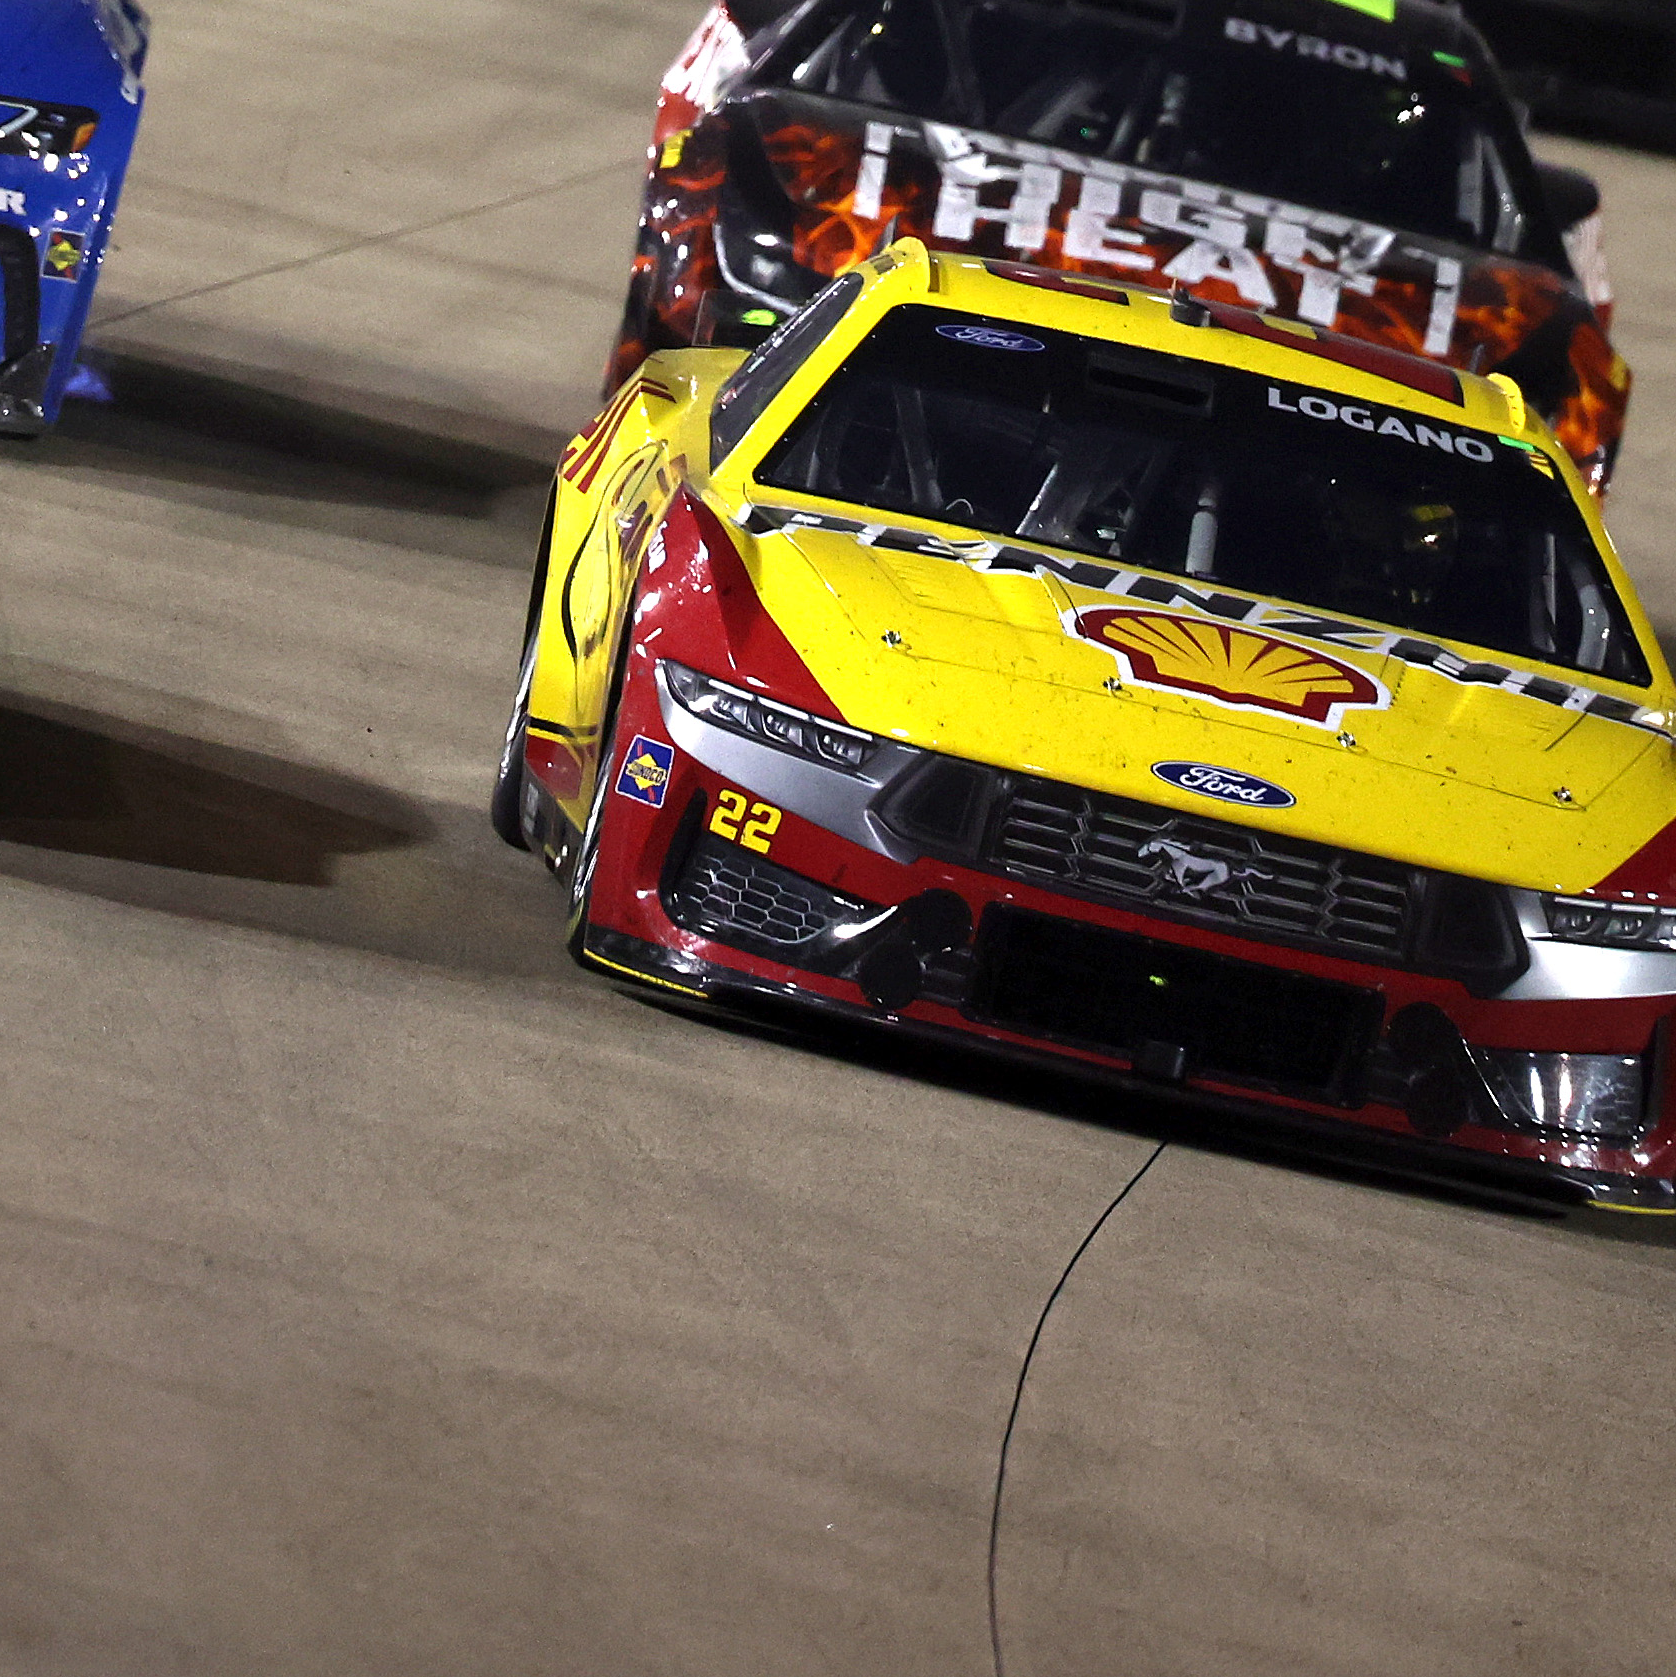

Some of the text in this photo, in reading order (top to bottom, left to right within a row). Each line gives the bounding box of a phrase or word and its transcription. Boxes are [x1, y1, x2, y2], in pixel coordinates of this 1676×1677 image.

[1224, 17, 1407, 81] BYRON
[931, 186, 1377, 327] HEAT
[1267, 386, 1494, 464] LOGANO
[627, 760, 665, 783] SUNOCO
[1179, 766, 1269, 802] Ford
[709, 789, 782, 854] 22
